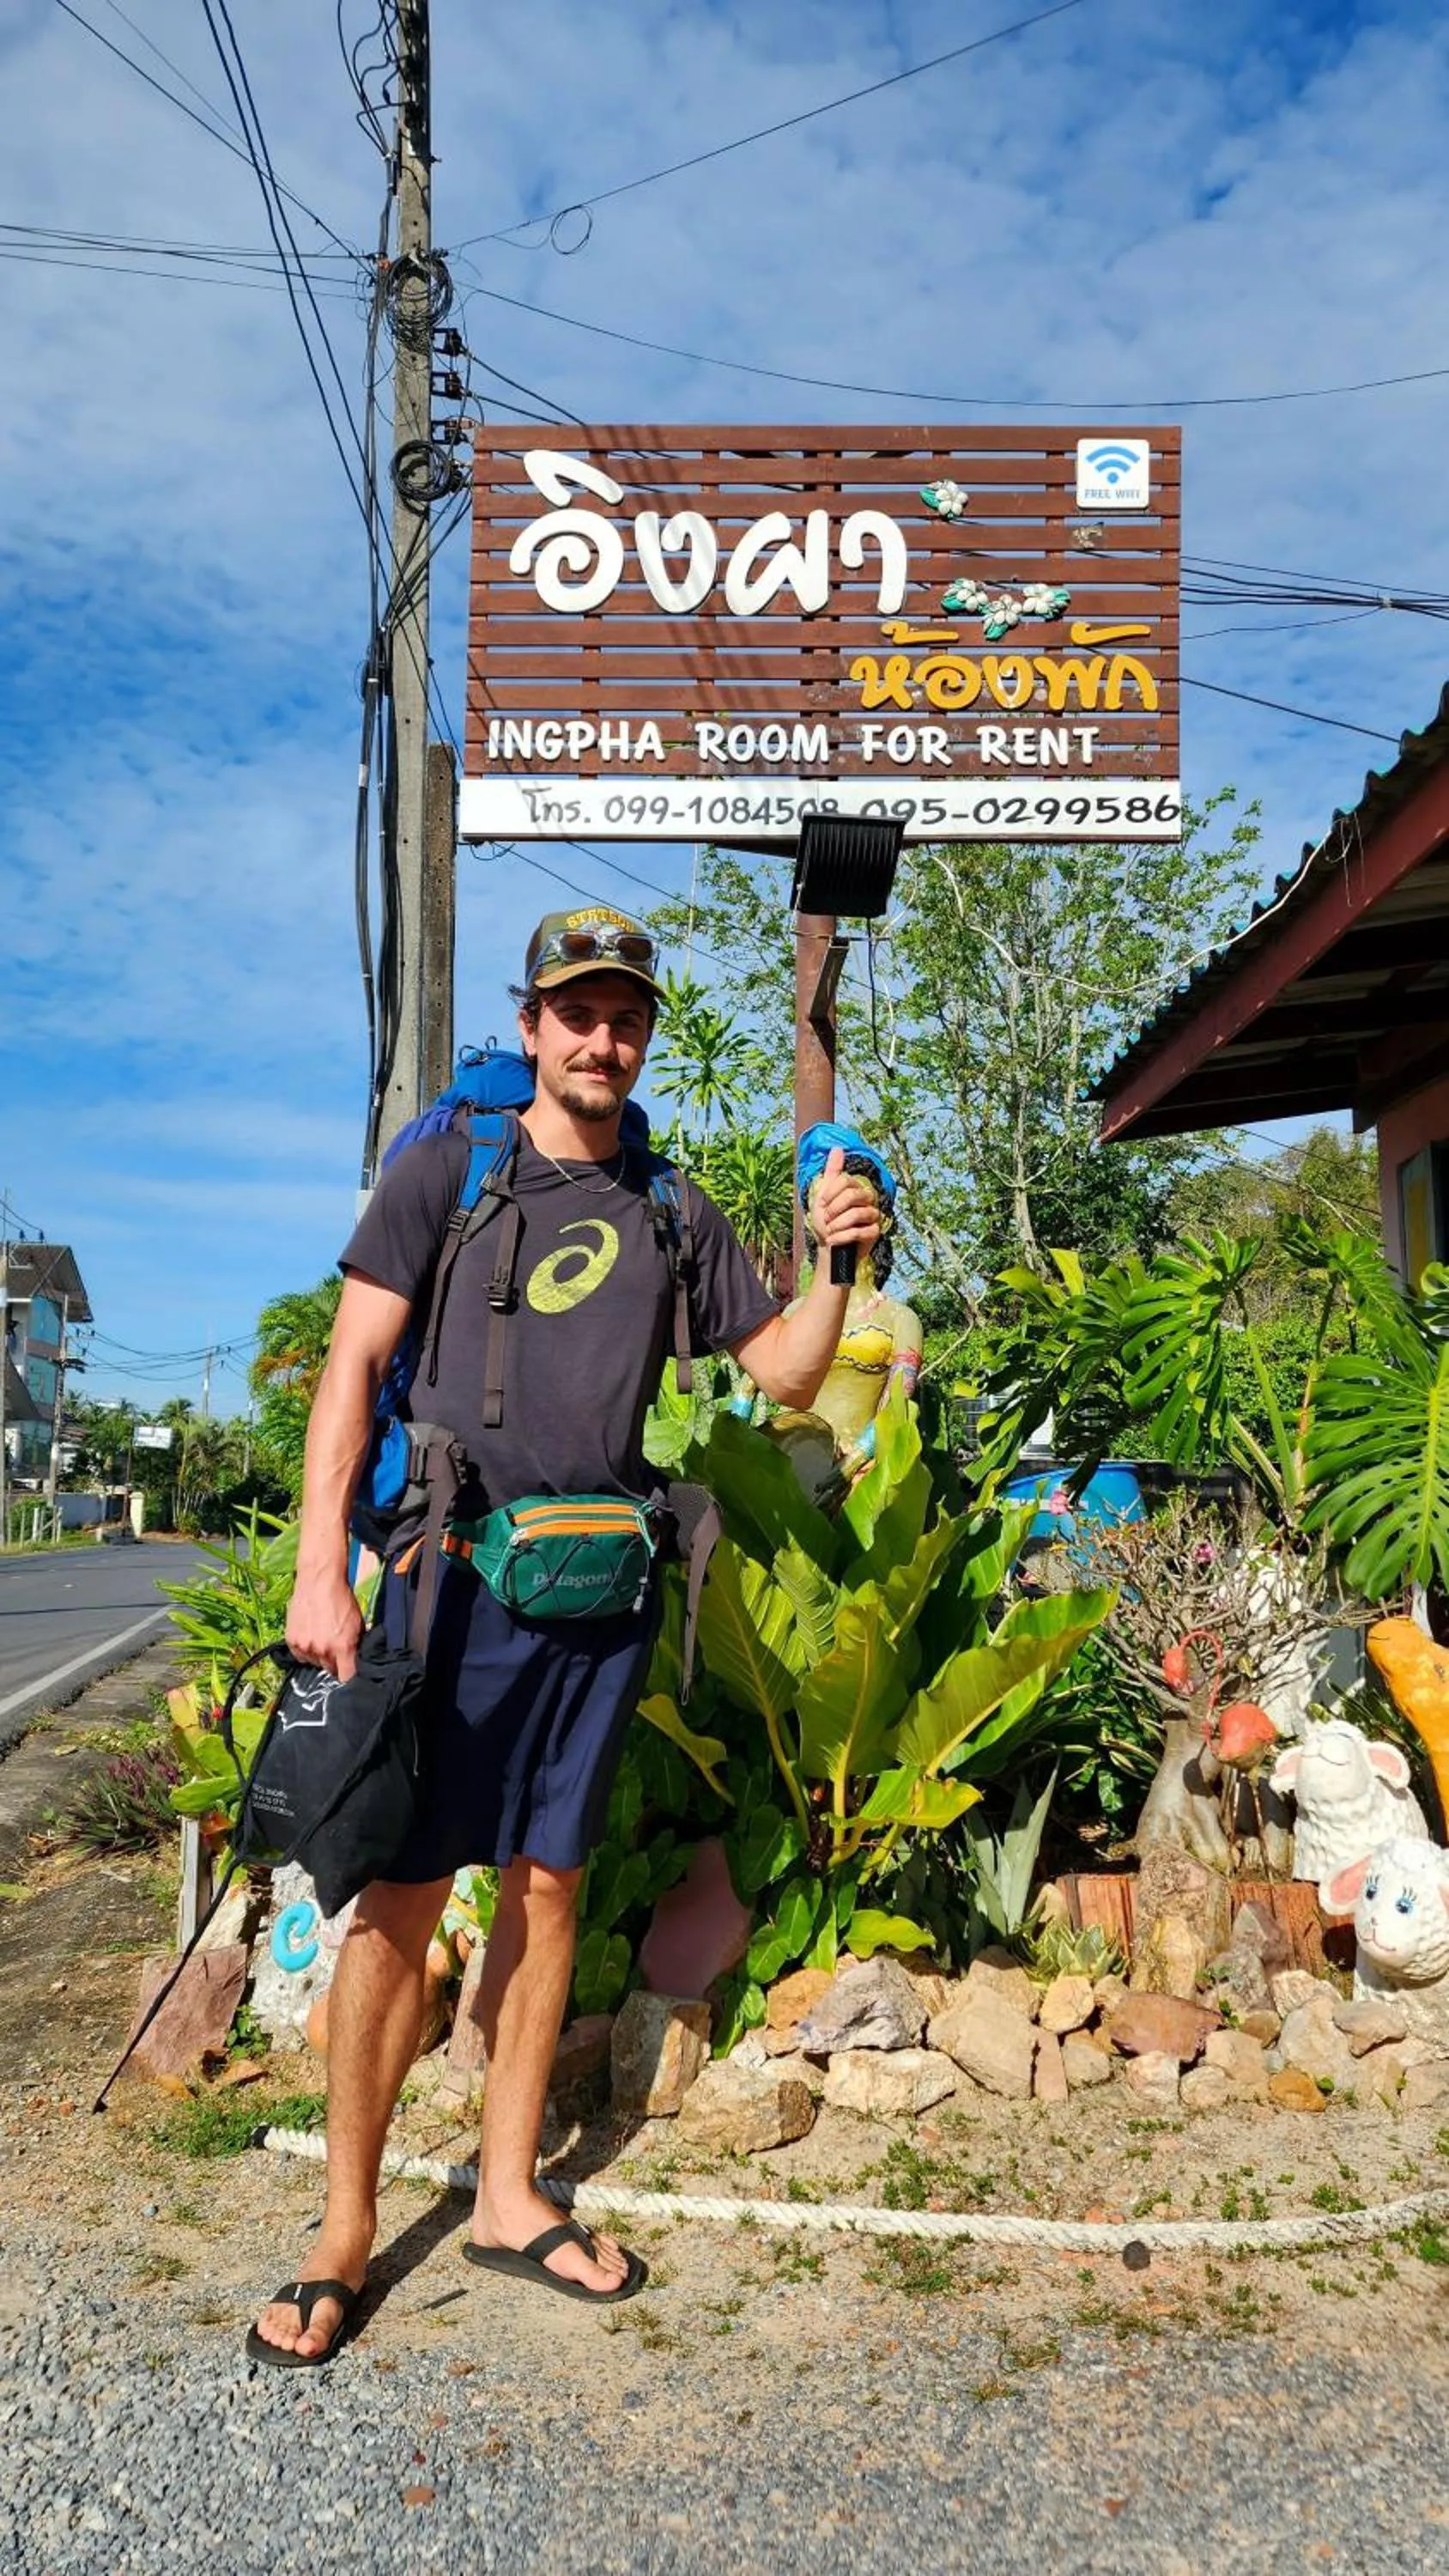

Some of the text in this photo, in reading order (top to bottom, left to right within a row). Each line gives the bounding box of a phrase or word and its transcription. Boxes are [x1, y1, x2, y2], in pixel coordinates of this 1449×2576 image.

[1084, 489, 1141, 499] FREE WIFI
[509, 449, 907, 616] อิงผา
[849, 620, 1159, 711] ห้องพัก
[488, 720, 1100, 767] INGPHA ROOM FOR RENT
